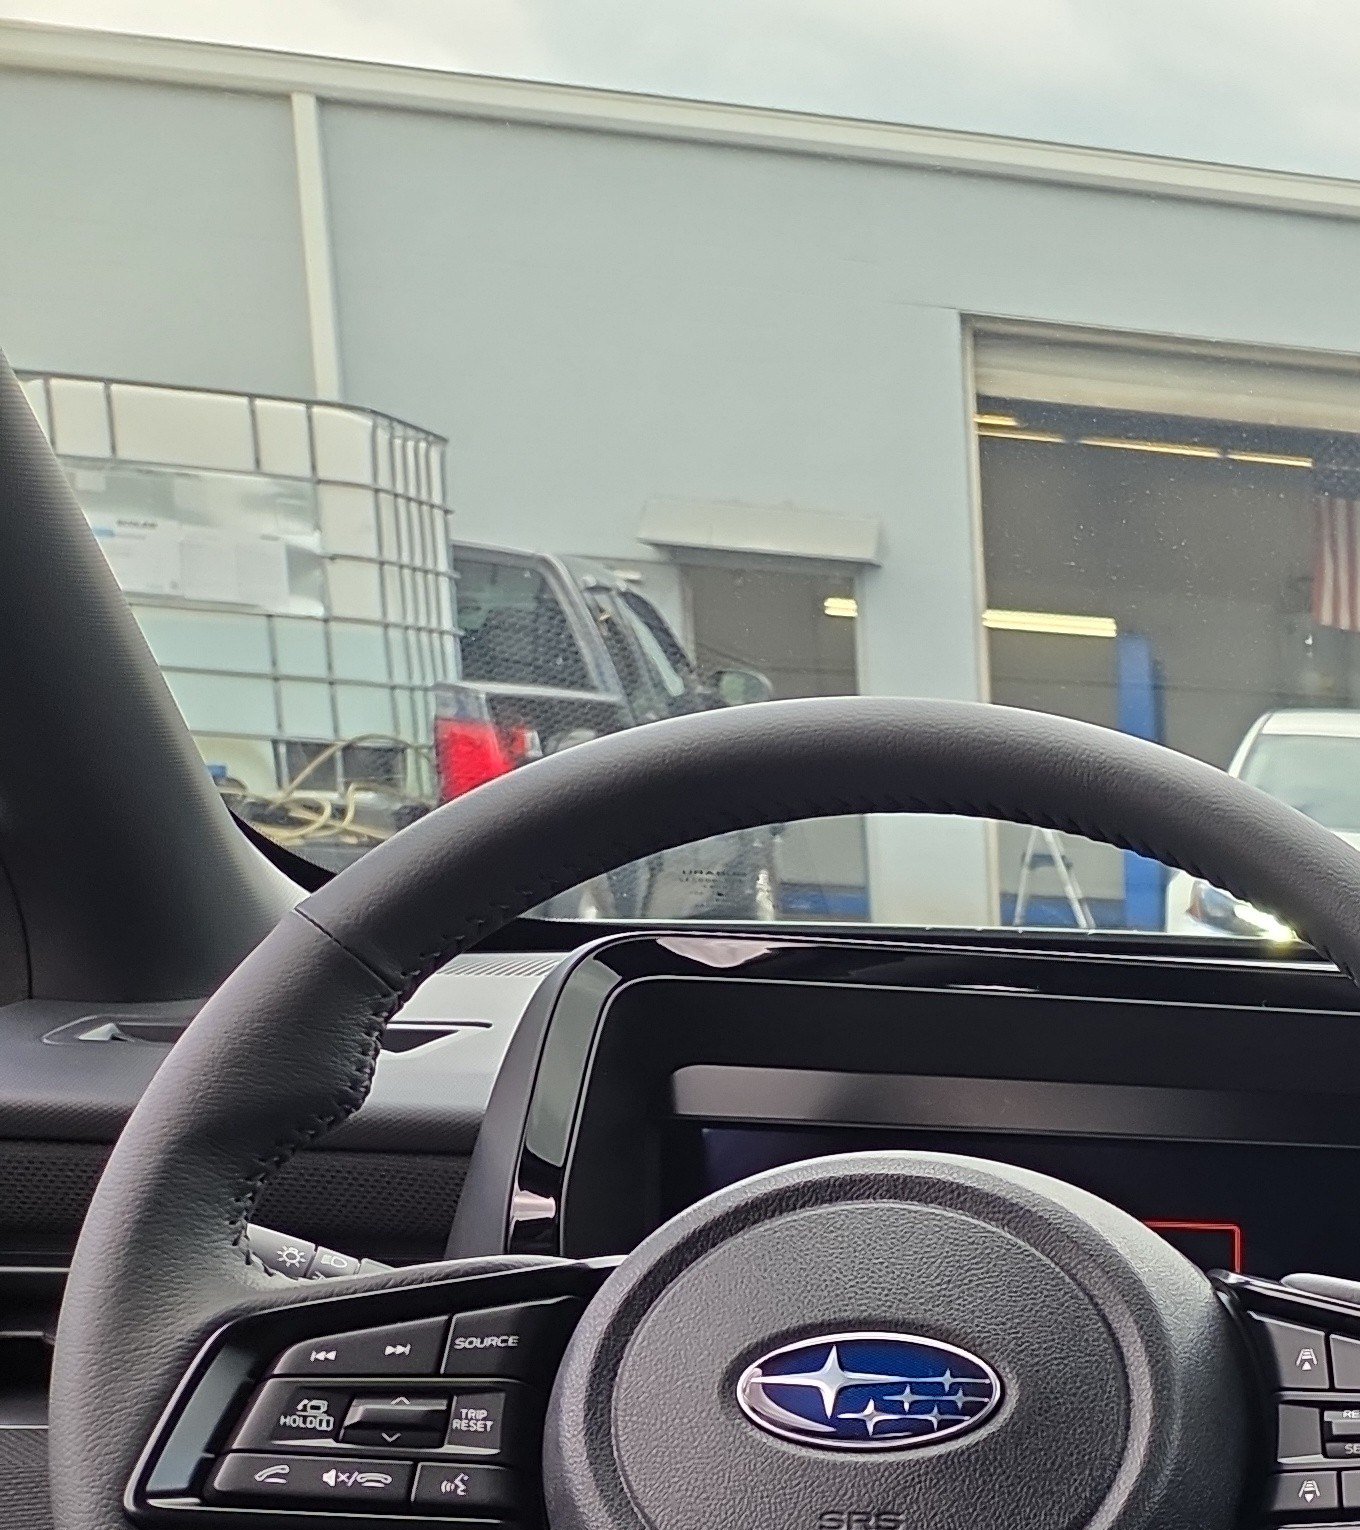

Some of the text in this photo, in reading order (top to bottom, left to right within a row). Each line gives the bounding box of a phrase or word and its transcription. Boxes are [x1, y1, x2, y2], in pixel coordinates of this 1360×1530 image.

[454, 1335, 519, 1350] SOURCE
[460, 1408, 488, 1421] TRIP
[452, 1418, 494, 1433] RESET
